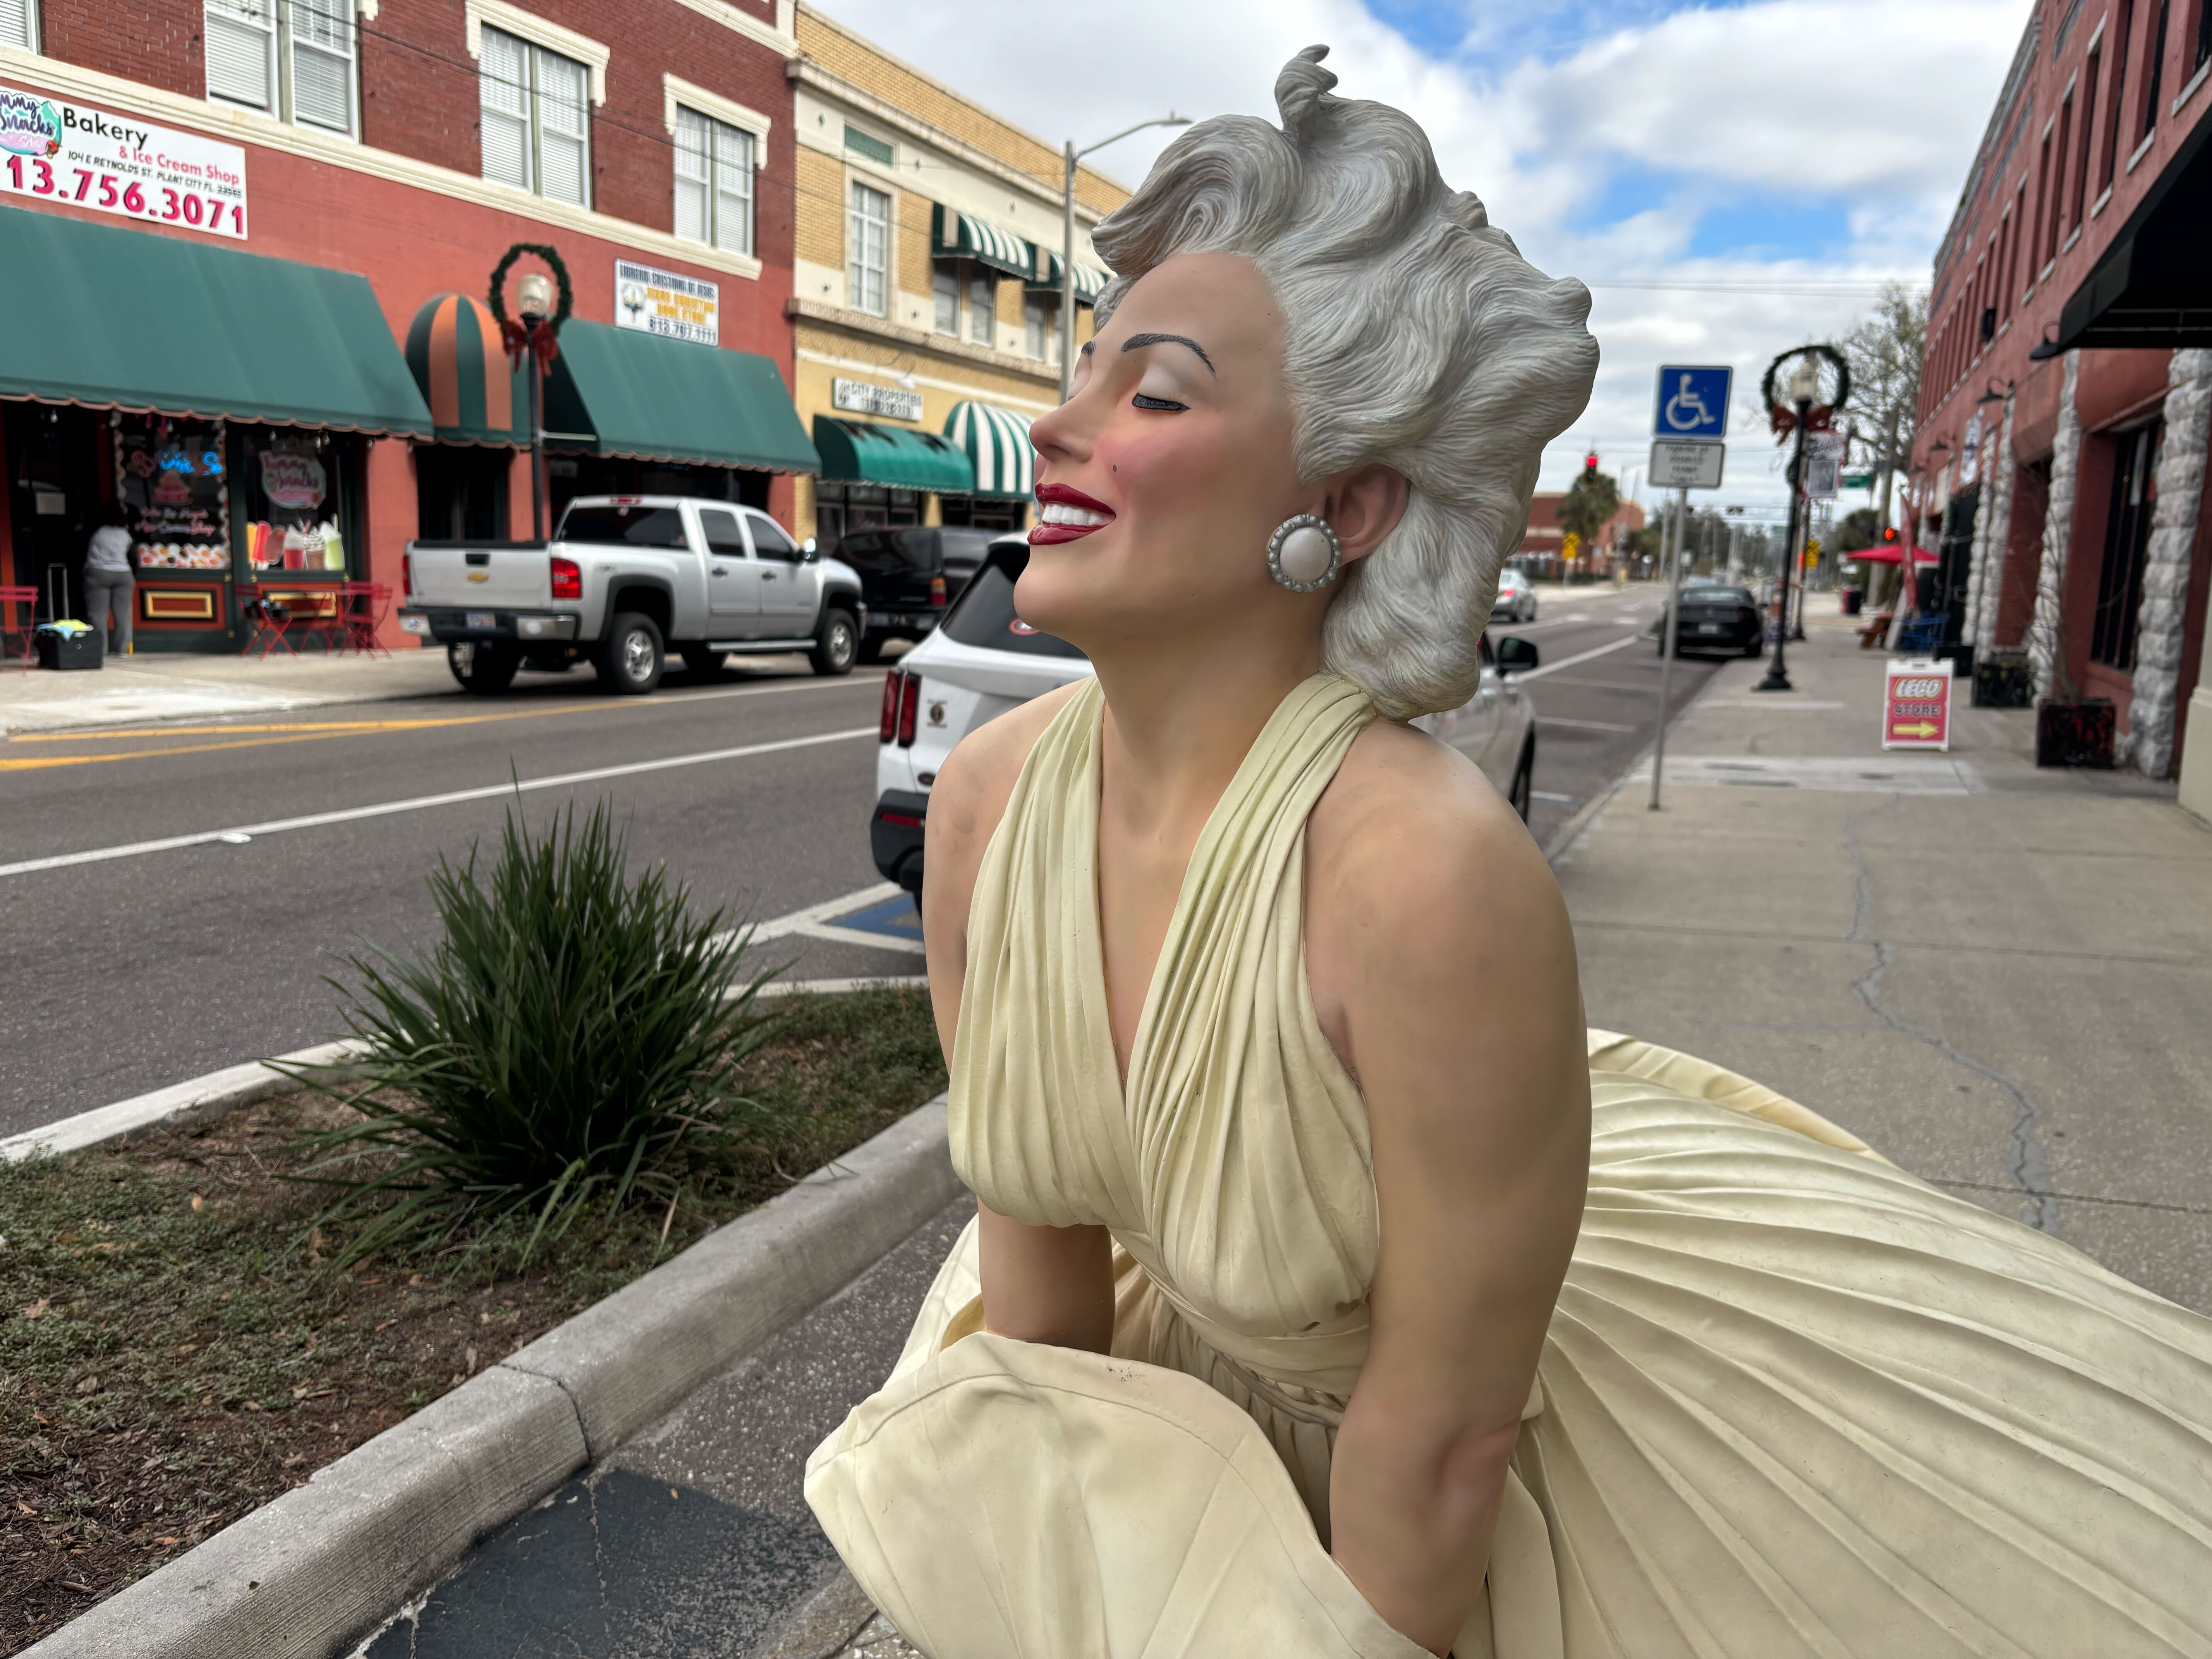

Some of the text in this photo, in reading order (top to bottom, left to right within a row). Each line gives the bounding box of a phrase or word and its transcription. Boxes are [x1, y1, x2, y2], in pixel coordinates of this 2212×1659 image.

[64, 107, 148, 150] Bakery
[69, 150, 84, 163] 104
[86, 155, 92, 164] E
[94, 156, 139, 175] REYNOLDS
[156, 170, 183, 186] PLANT
[185, 177, 202, 190] CITY
[119, 146, 240, 186] & Ice Cream Shop
[1896, 679, 1941, 697] LEGO
[1895, 702, 1940, 718] STORE
